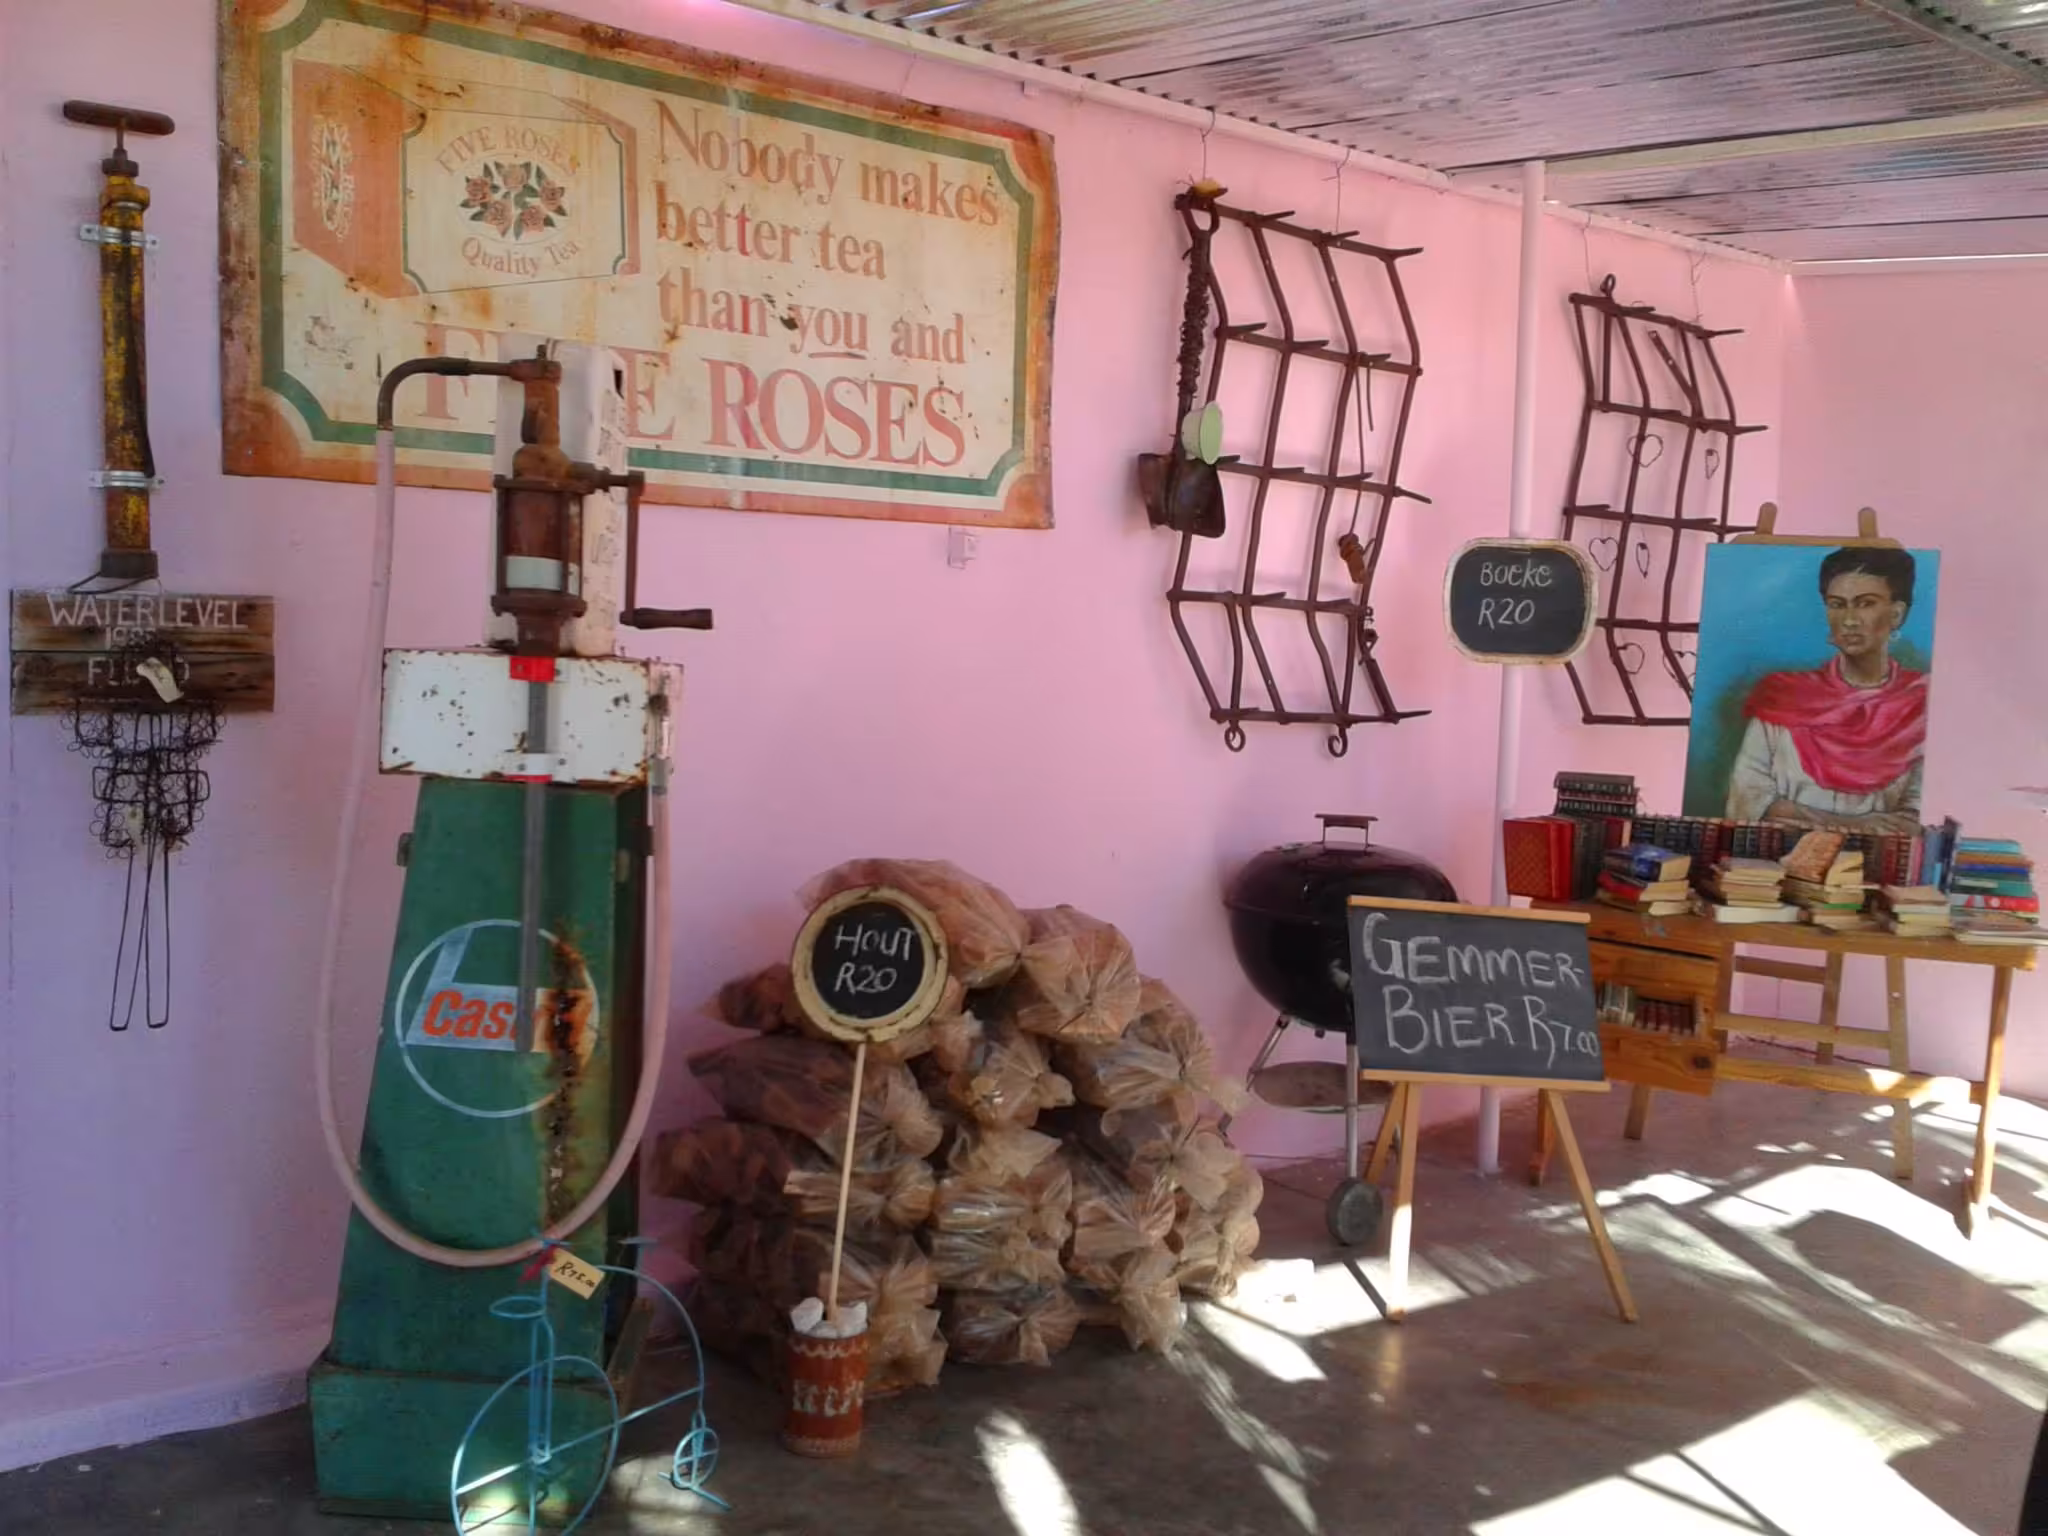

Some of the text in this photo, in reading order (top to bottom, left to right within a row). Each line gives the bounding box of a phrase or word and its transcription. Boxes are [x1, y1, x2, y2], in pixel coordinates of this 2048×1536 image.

[436, 126, 497, 176] FIVE
[654, 98, 1000, 227] Nobody makes
[461, 237, 580, 278] Quality Tea
[654, 180, 886, 281] better tea
[656, 266, 967, 364] than you and
[413, 320, 967, 469] FE ROSES
[1478, 597, 1536, 630] R20
[834, 961, 898, 995] R20
